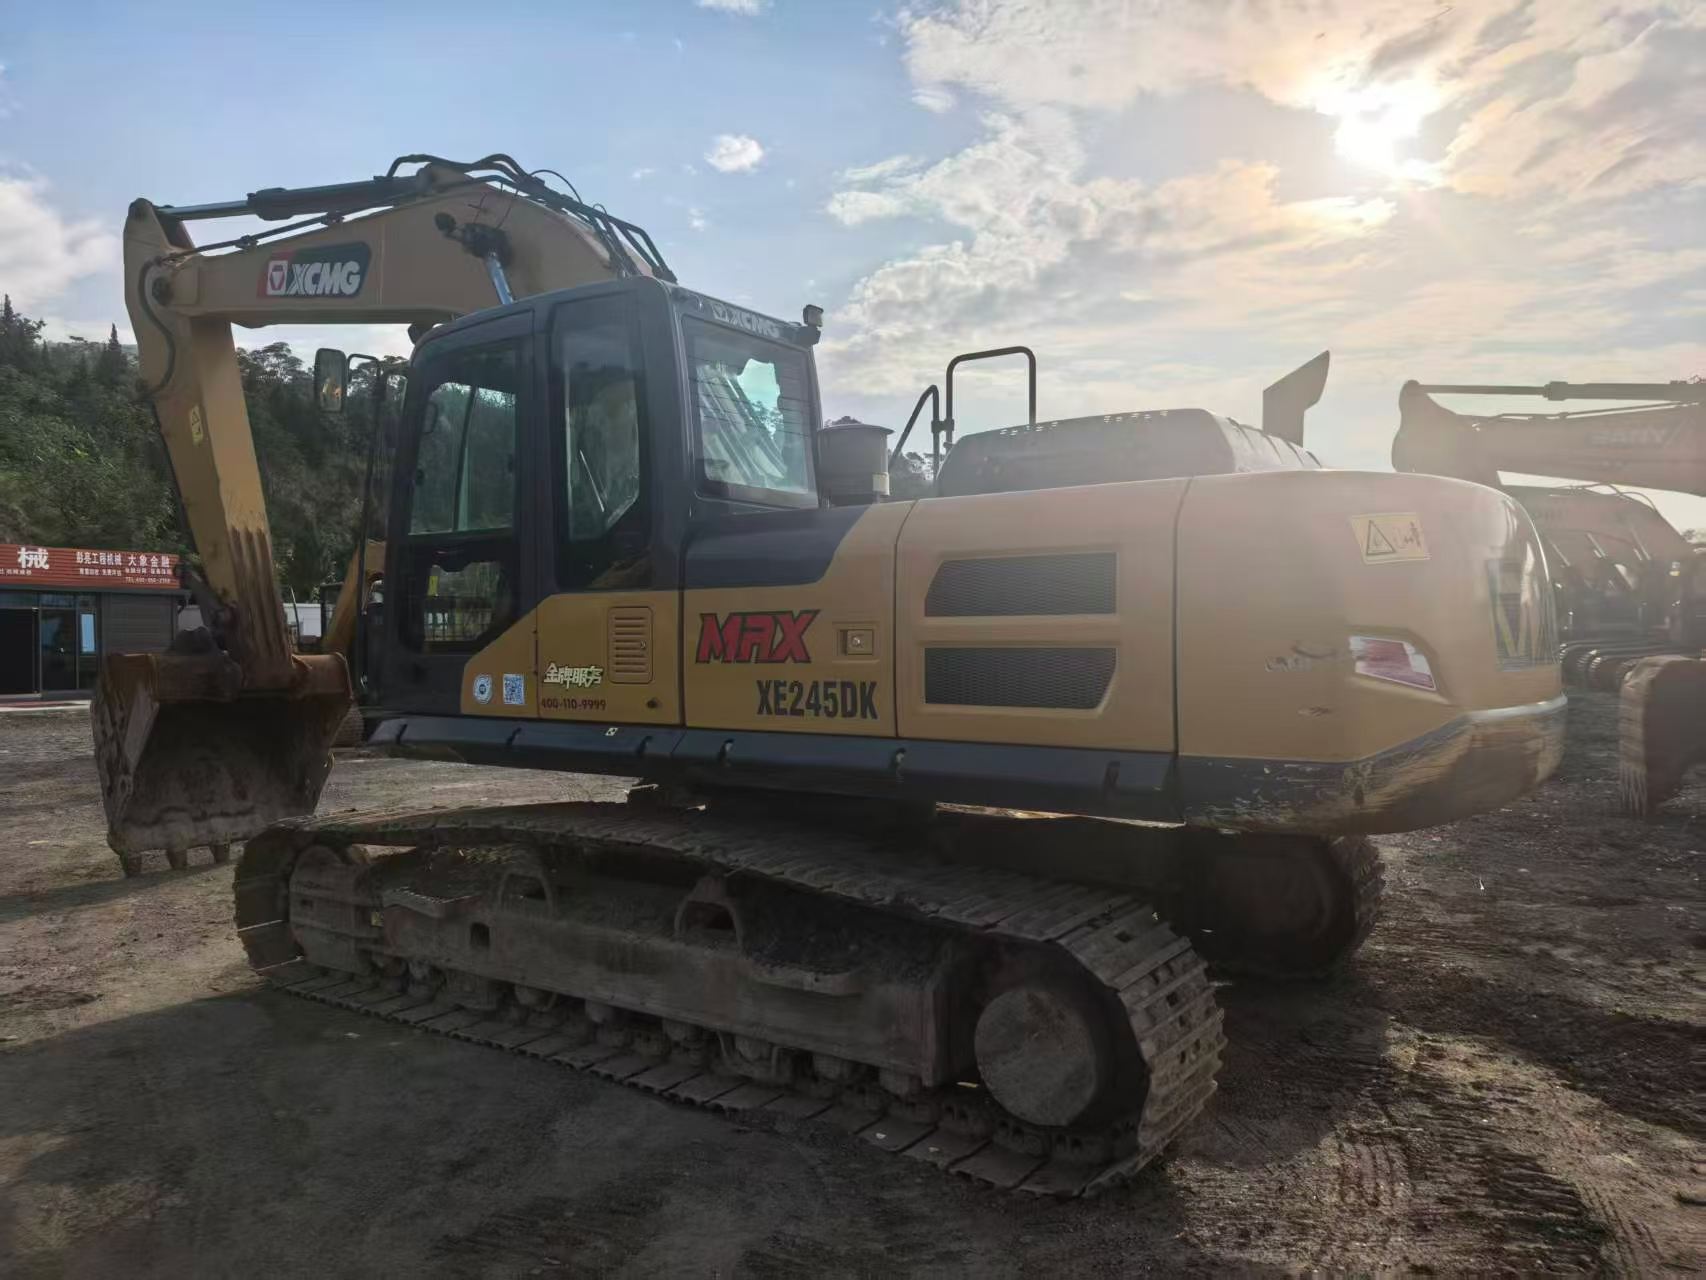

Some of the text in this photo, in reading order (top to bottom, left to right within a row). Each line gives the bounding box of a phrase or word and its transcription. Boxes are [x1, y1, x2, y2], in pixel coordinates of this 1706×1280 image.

[287, 261, 361, 295] XCMG
[729, 309, 780, 338] XCMG
[17, 547, 50, 569] 械
[128, 553, 170, 567] 大象金融
[695, 609, 821, 664] MAX
[543, 662, 603, 689] 金牌服务
[541, 698, 606, 711] 400-110-9999
[756, 680, 878, 719] XE245DK
